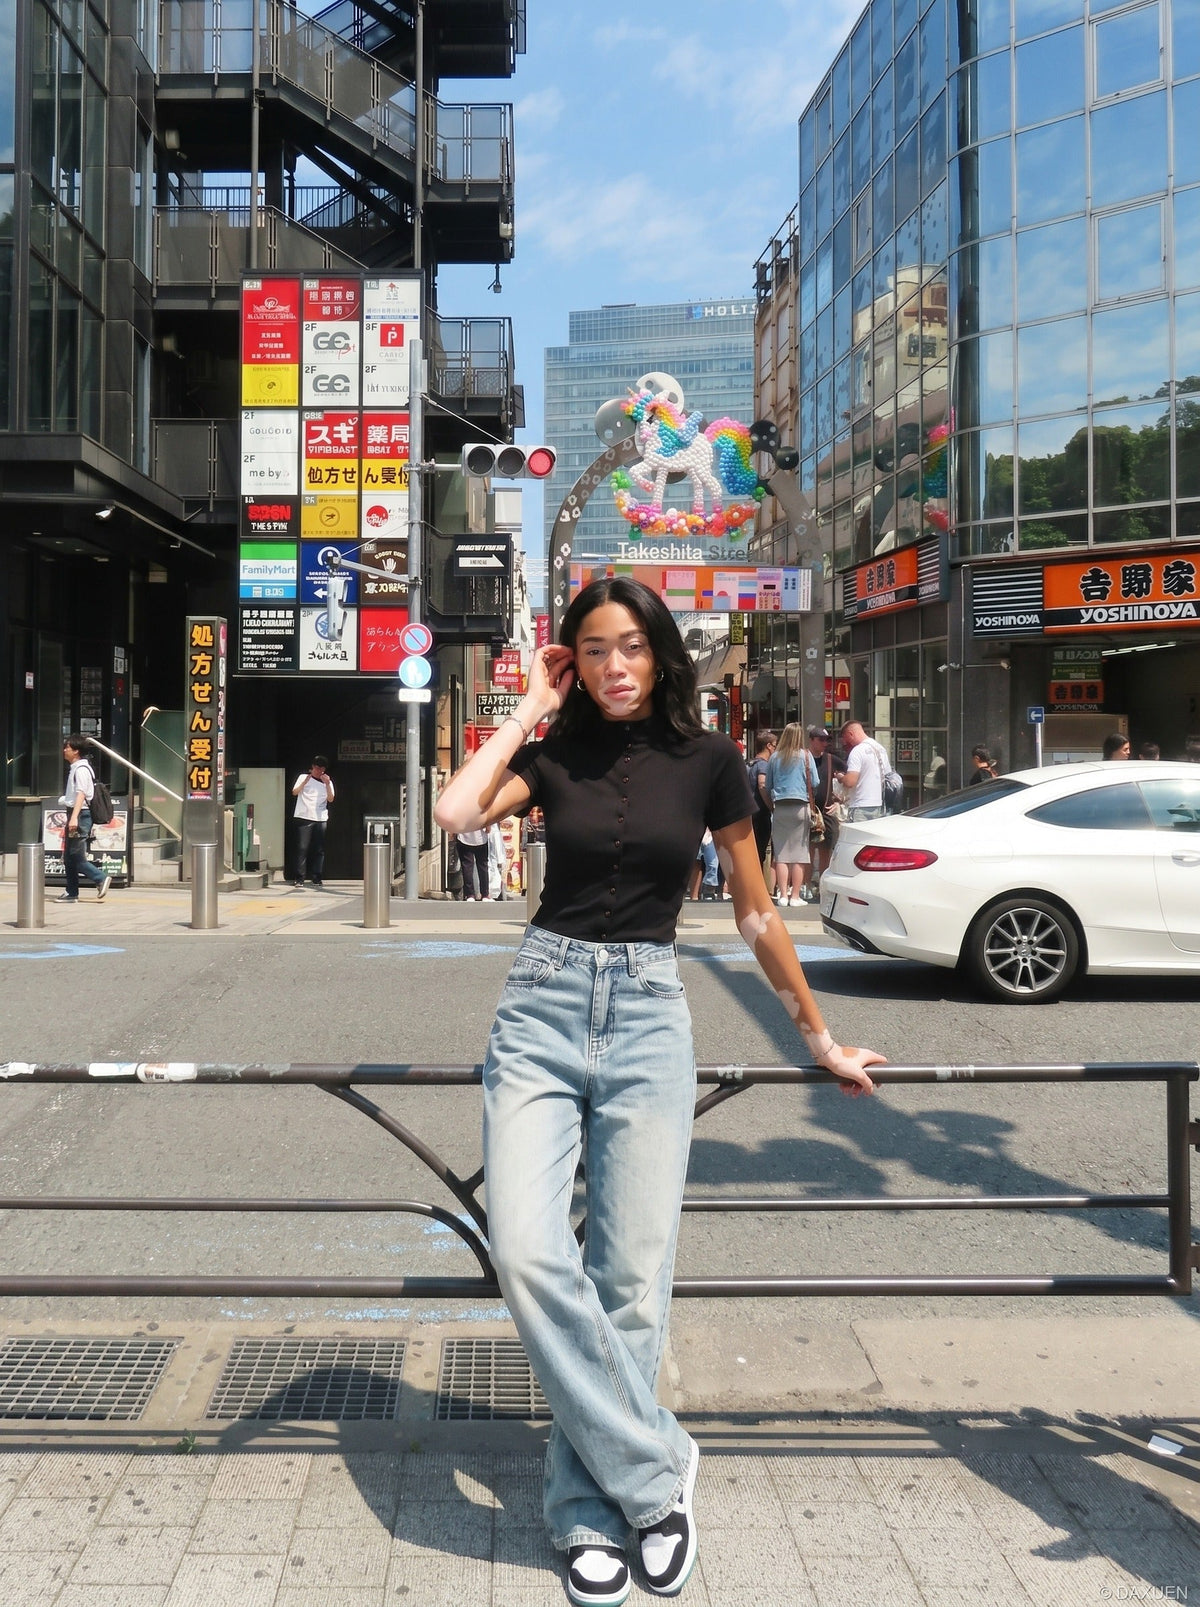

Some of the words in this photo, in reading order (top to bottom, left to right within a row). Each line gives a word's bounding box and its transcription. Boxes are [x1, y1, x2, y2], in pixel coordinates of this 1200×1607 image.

[305, 323, 317, 331] 2F
[304, 366, 317, 374] 2F
[244, 411, 255, 420] 2F
[243, 455, 255, 463] 2F
[617, 542, 703, 560] Takeshita
[242, 565, 295, 576] FamilyMart
[1079, 558, 1197, 603] 吉野家
[1079, 602, 1199, 624] YOSHINOYA
[975, 613, 1041, 627] YOSHINOYA
[189, 624, 214, 789] 処方せん受付
